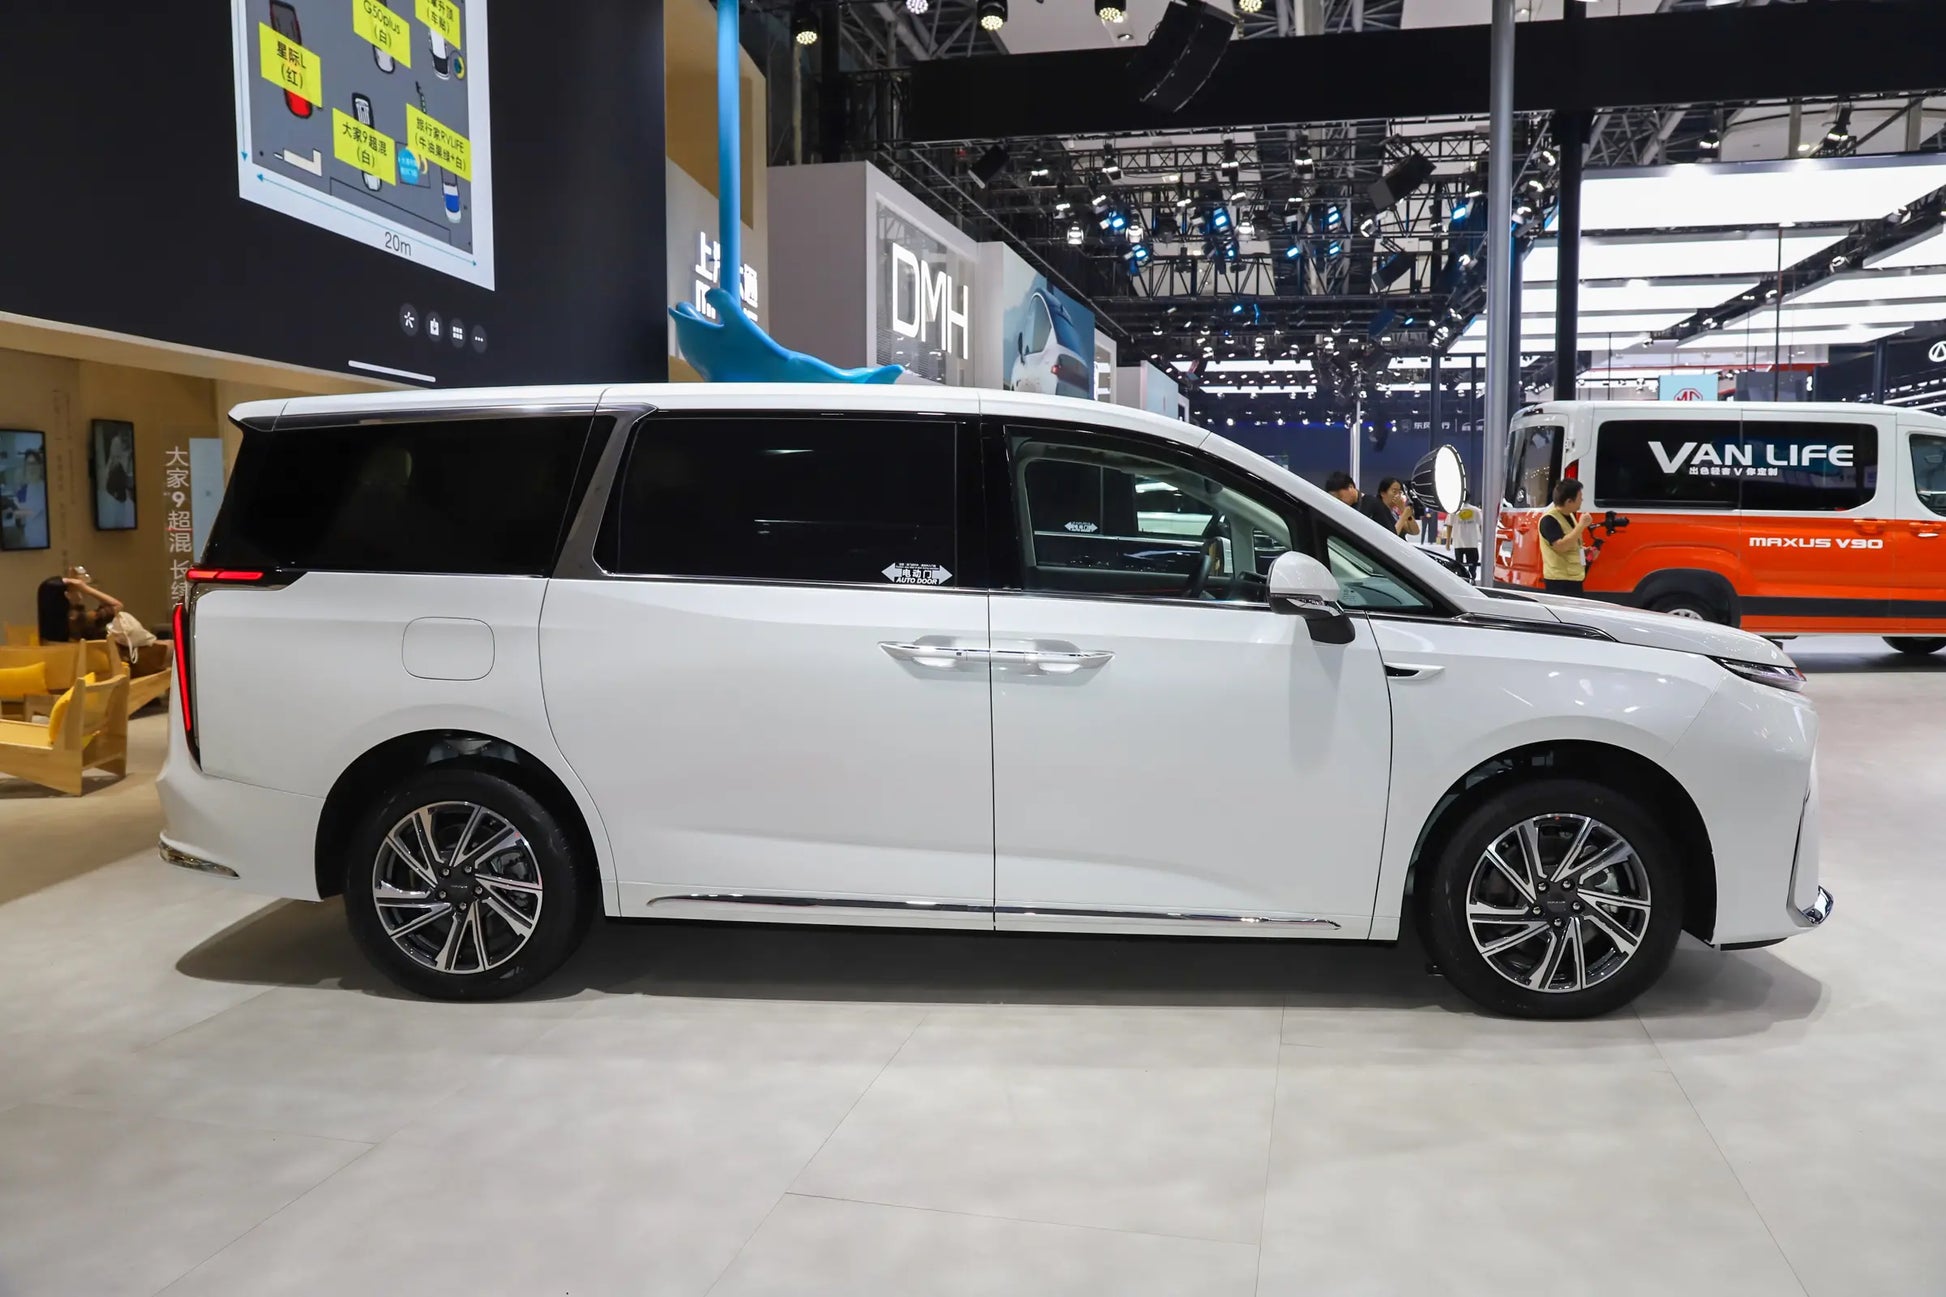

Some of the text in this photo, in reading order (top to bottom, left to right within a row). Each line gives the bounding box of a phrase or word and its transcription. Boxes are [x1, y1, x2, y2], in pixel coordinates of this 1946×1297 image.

[281, 64, 303, 89] (红)
[385, 231, 412, 257] 20m
[893, 242, 968, 360] DMH
[1648, 441, 1854, 474] VAN LIFE
[165, 446, 192, 553] 大家9超混
[1749, 537, 1883, 549] MAXUS V90
[902, 569, 932, 578] 电动门
